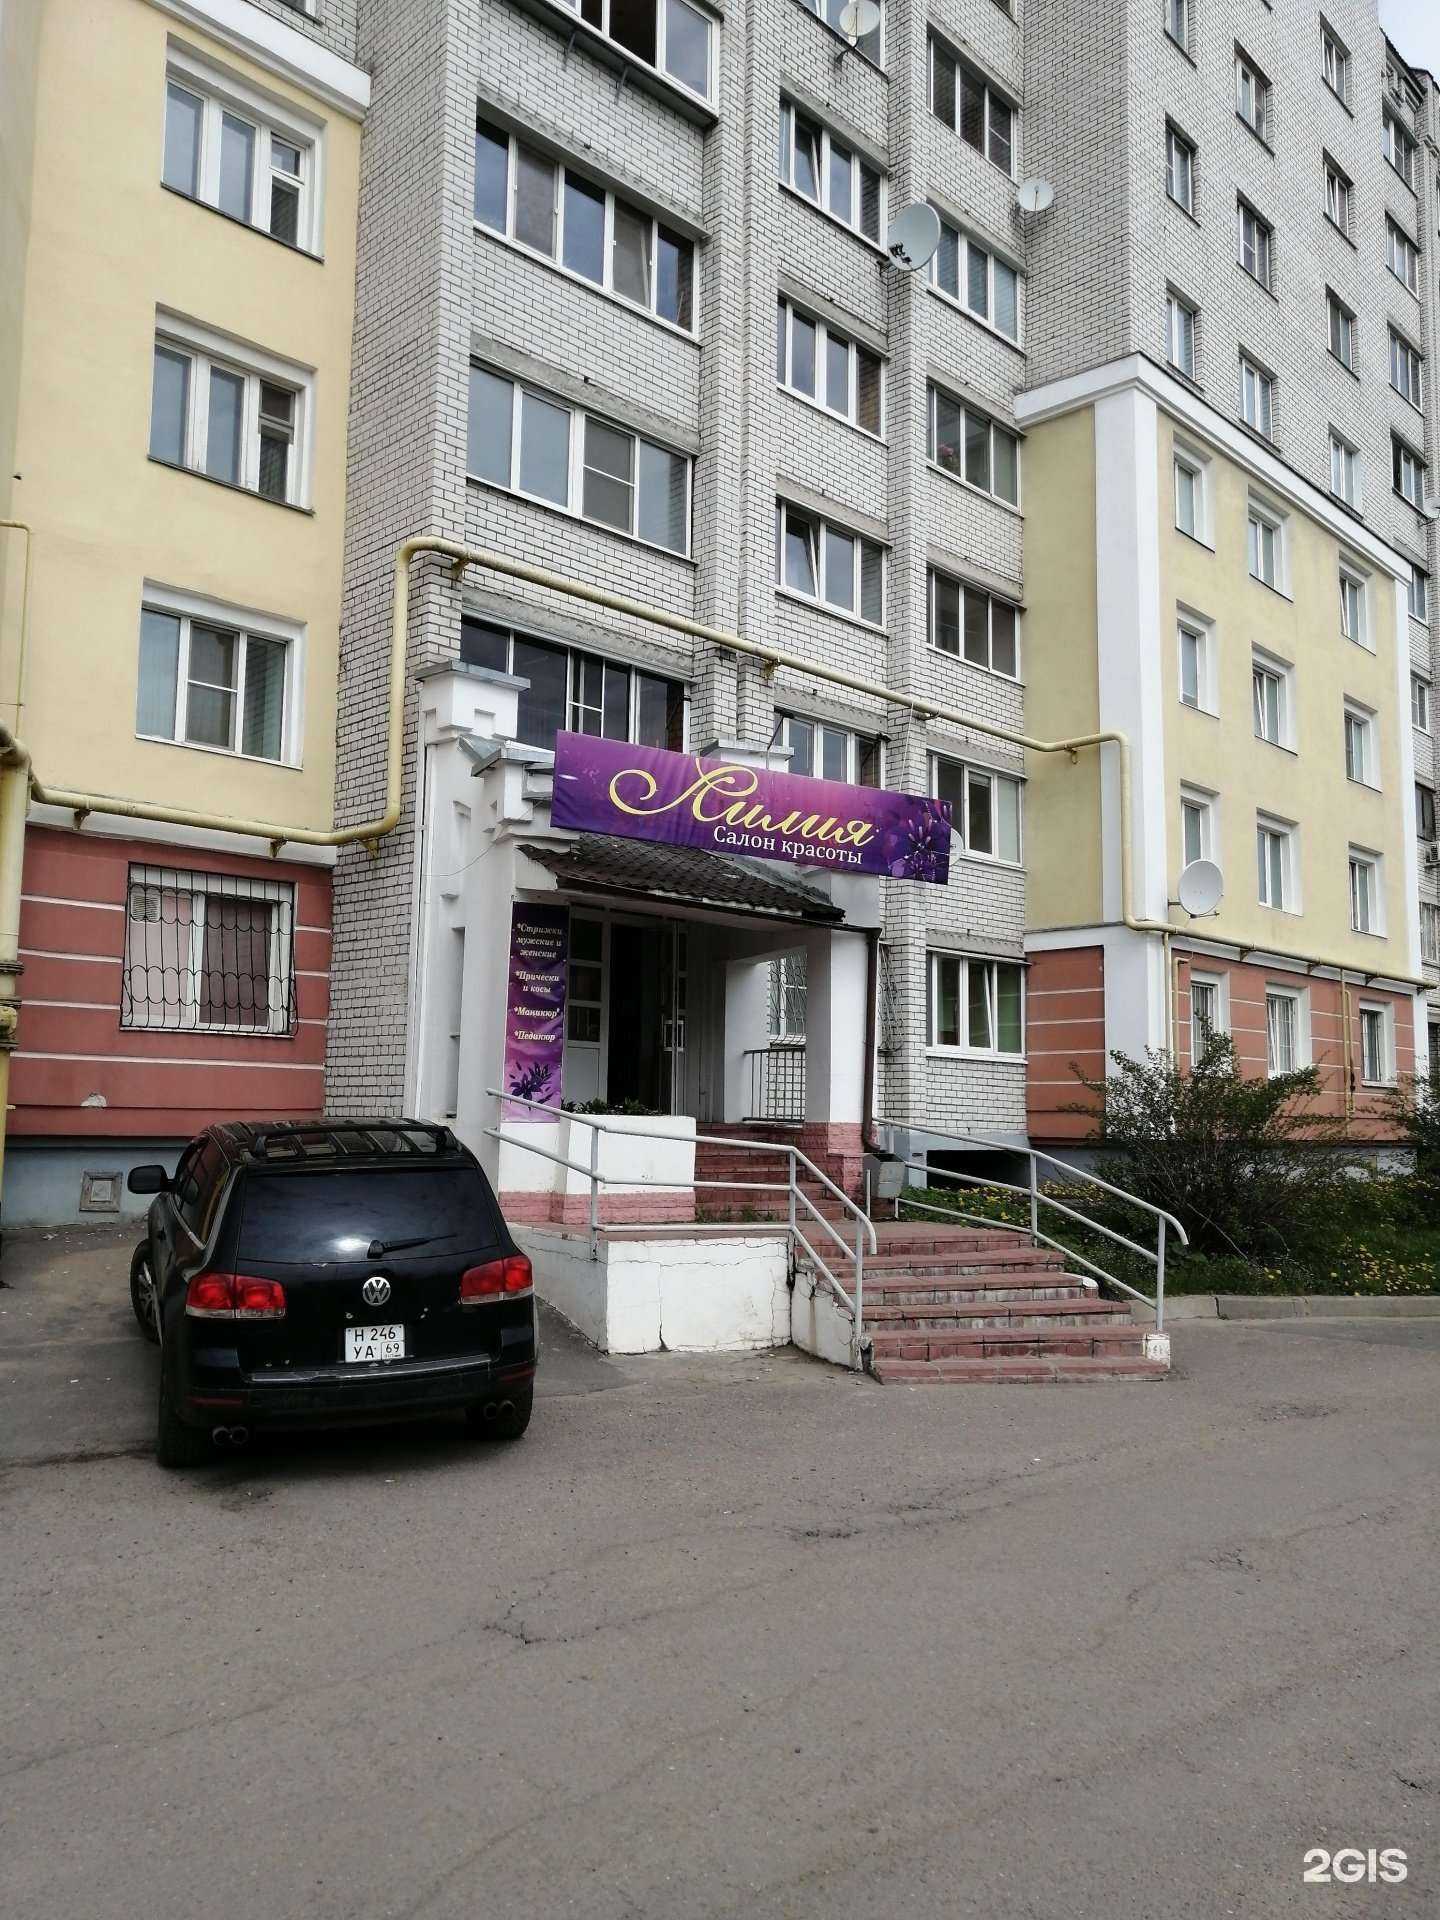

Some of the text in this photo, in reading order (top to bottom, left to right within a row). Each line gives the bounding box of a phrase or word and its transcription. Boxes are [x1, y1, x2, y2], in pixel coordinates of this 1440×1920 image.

[713, 825, 864, 865] Салон красоты
[520, 949, 557, 958] женские
[530, 985, 551, 993] косы
[370, 1326, 396, 1341] 246
[385, 1343, 400, 1354] 69
